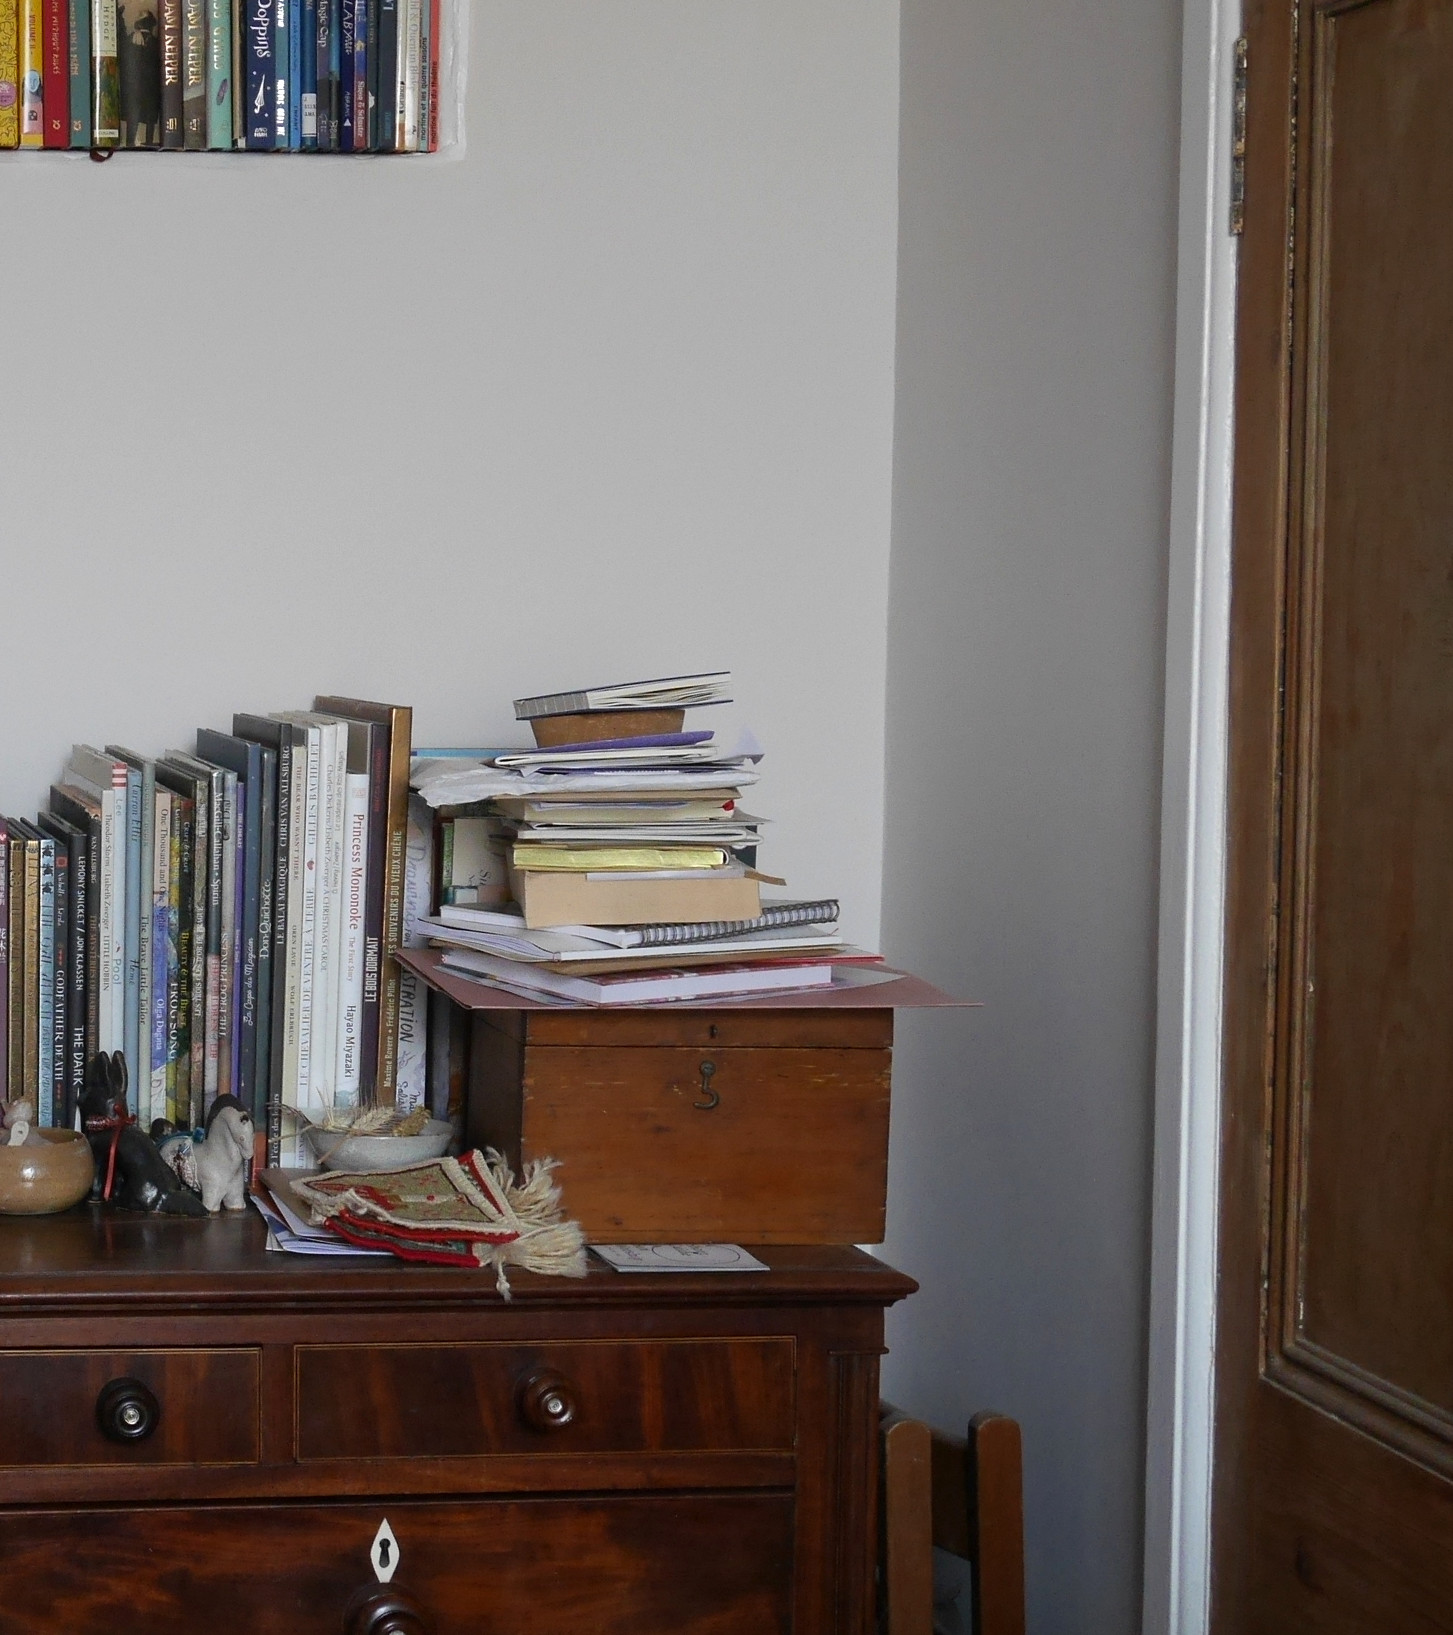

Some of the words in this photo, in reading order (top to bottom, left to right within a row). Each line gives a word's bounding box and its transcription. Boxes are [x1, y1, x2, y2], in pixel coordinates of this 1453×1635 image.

[51, 16, 60, 51] WITHOUT
[317, 26, 329, 47] Cap
[52, 53, 61, 75] RULES
[164, 34, 178, 86] KEEPER
[187, 34, 201, 86] KEEPER
[356, 80, 365, 100] Simon
[356, 108, 366, 138] Schuster
[281, 746, 290, 795] ALLSBURG
[115, 798, 123, 816] Lee
[159, 808, 169, 828] One
[280, 796, 289, 817] VAN
[279, 818, 288, 847] CHRIS
[351, 813, 365, 863] Princess
[159, 828, 169, 868] Thousand
[76, 856, 86, 889] LEMONY
[159, 869, 168, 885] and
[277, 856, 289, 902] MAGIQUE
[404, 844, 428, 927] Drawing
[76, 890, 86, 925] SNICKET
[158, 885, 167, 902] One
[349, 867, 364, 930] Mononoke
[140, 914, 150, 933] The
[156, 904, 167, 932] Nights
[277, 902, 287, 931] BALAI
[76, 935, 85, 951] JON
[140, 936, 150, 964] Brave
[277, 933, 286, 945] LE
[348, 936, 356, 949] The
[405, 928, 413, 943] FOR
[347, 949, 356, 964] First
[365, 936, 380, 972] DORMAIT
[75, 953, 85, 991] KLASSEN
[112, 958, 122, 985] Pool
[139, 966, 149, 994] Little
[346, 965, 355, 982] Story
[365, 972, 378, 991] BOIS
[54, 969, 65, 1042] GODFATHER
[139, 996, 149, 1025] Tailor
[155, 998, 165, 1019] Olga
[168, 981, 178, 1019] FROG
[365, 992, 378, 1003] LE
[343, 1004, 357, 1034] Hayao
[73, 1024, 84, 1048] THE
[153, 1020, 164, 1050] Dugina
[168, 1022, 178, 1060] SONG
[54, 1044, 65, 1080] DEATH
[73, 1052, 84, 1086] DARK
[342, 1036, 356, 1078] Miyazaki
